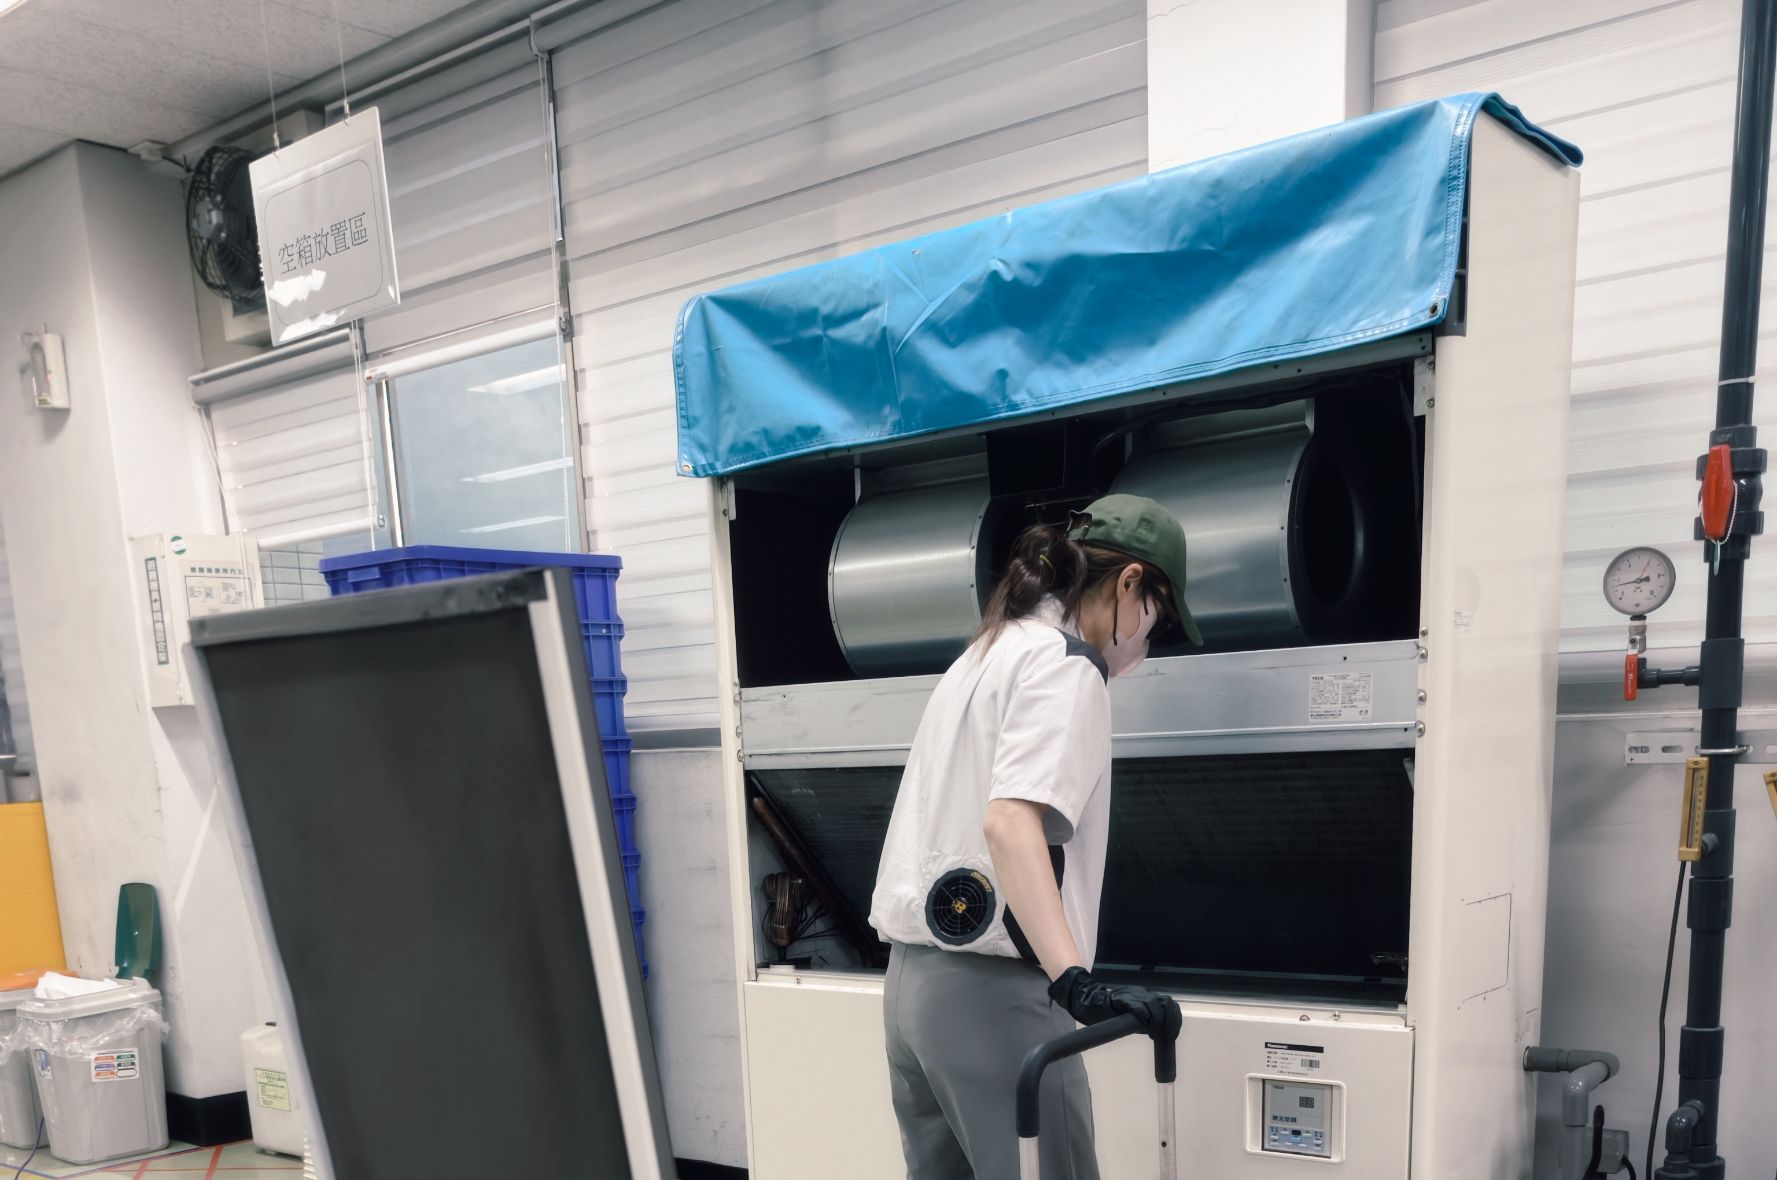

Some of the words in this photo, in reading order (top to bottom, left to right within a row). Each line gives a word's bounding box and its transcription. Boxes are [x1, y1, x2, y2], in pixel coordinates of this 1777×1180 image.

[279, 212, 368, 275] 空箱放置區
